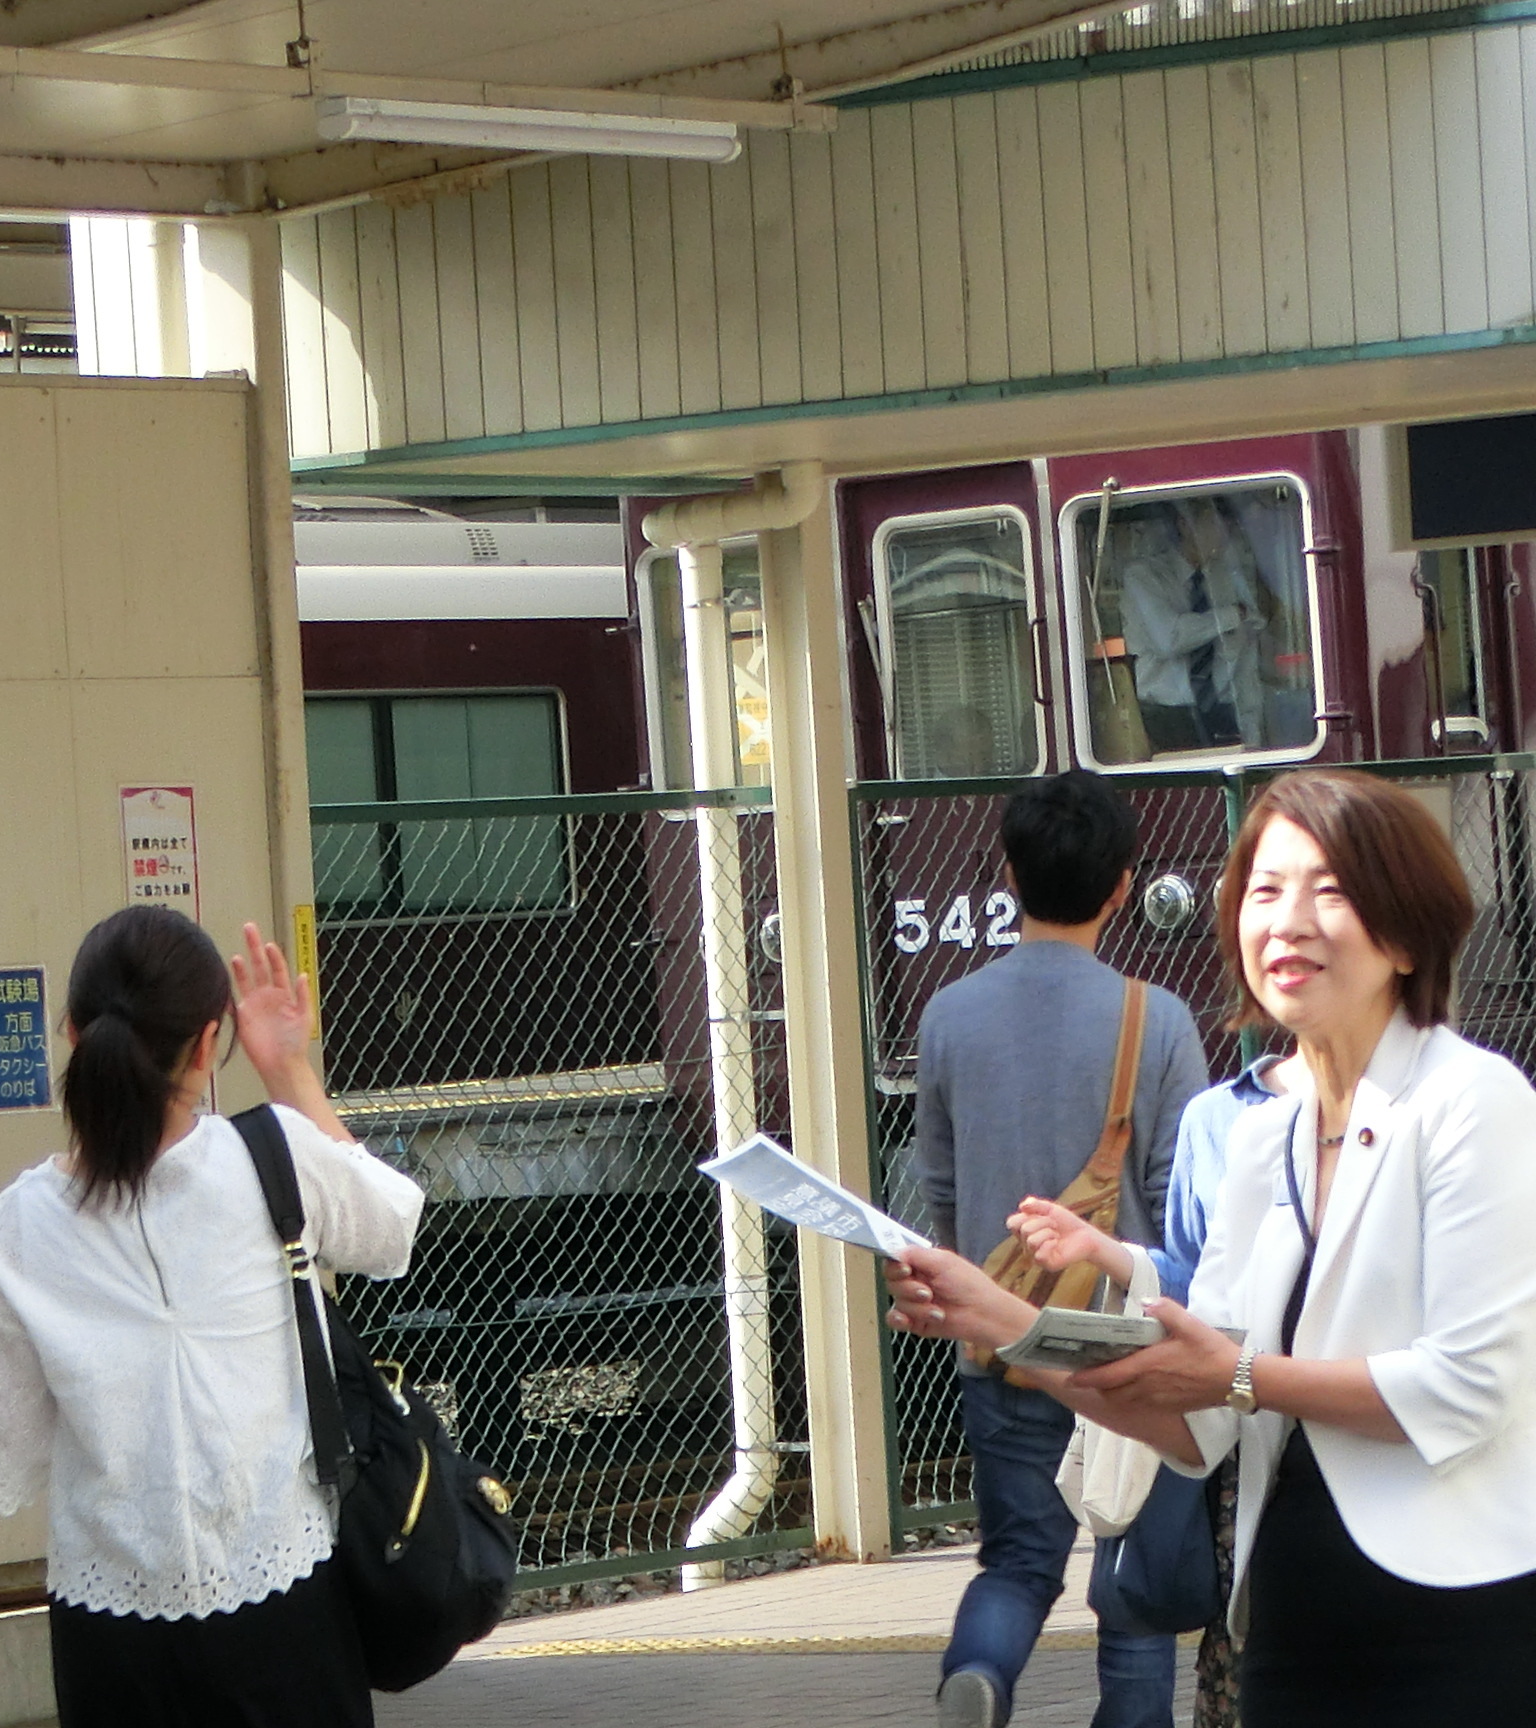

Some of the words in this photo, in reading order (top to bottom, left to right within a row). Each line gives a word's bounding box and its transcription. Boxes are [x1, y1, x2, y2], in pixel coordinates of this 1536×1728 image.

[5, 1011, 33, 1033] 方面
[0, 1058, 46, 1076] タクシー
[0, 1078, 37, 1098] のりば
